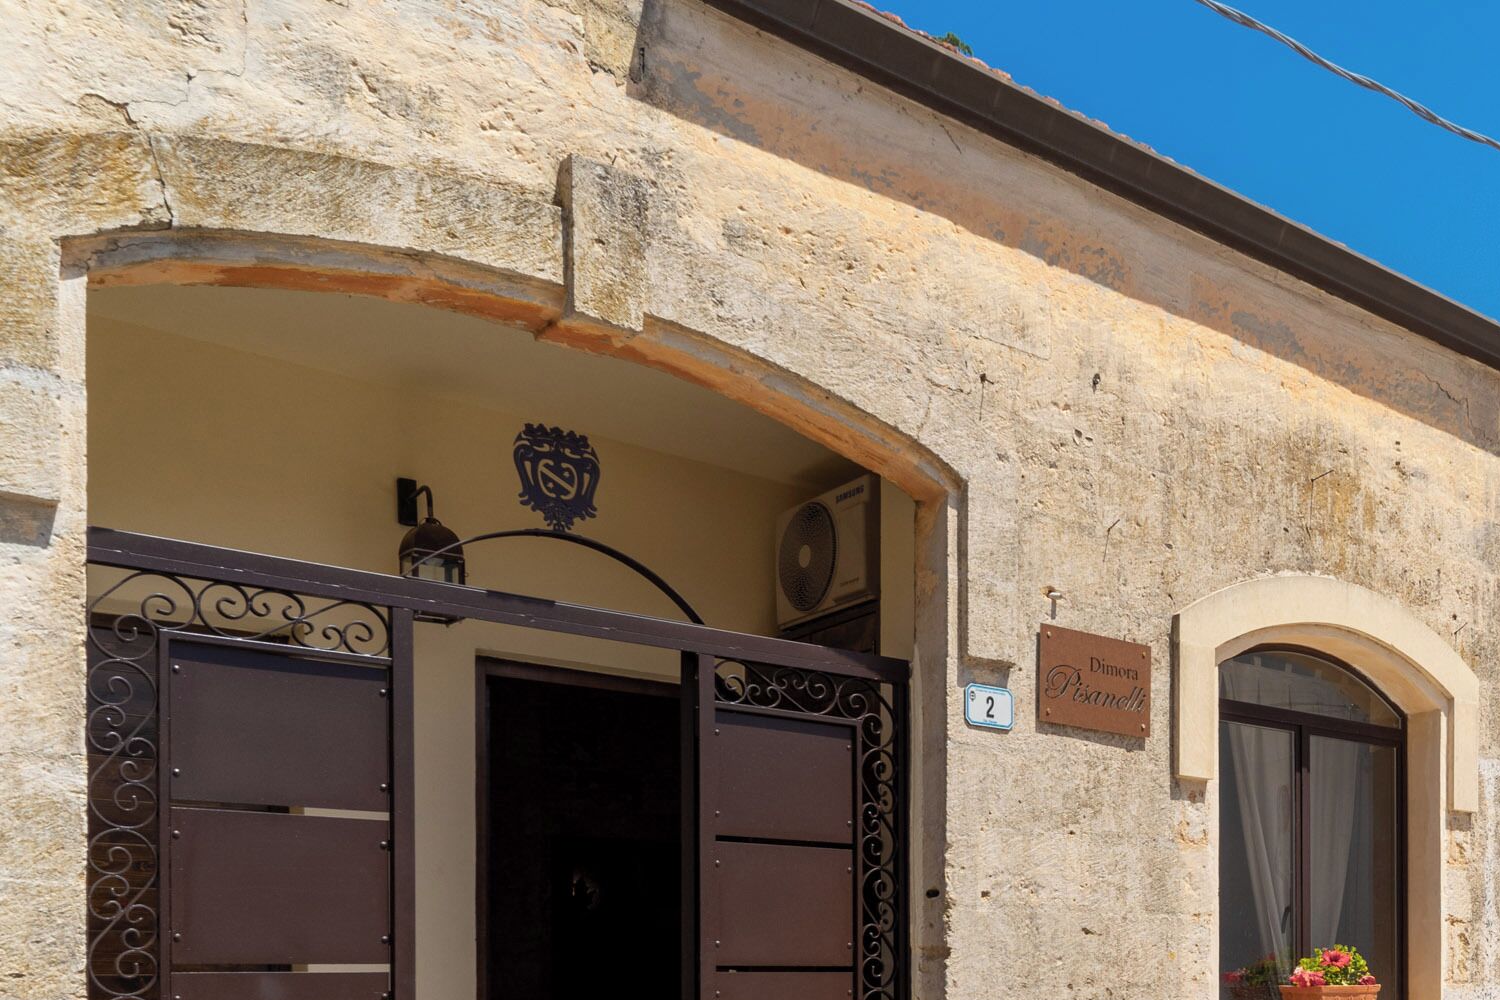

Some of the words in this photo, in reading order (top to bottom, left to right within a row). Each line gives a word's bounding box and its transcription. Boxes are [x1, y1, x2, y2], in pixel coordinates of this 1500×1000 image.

[835, 485, 864, 504] SAMSUNG
[1090, 657, 1139, 681] Dimora
[1044, 664, 1147, 714] Pisanelli
[986, 696, 995, 718] 2
